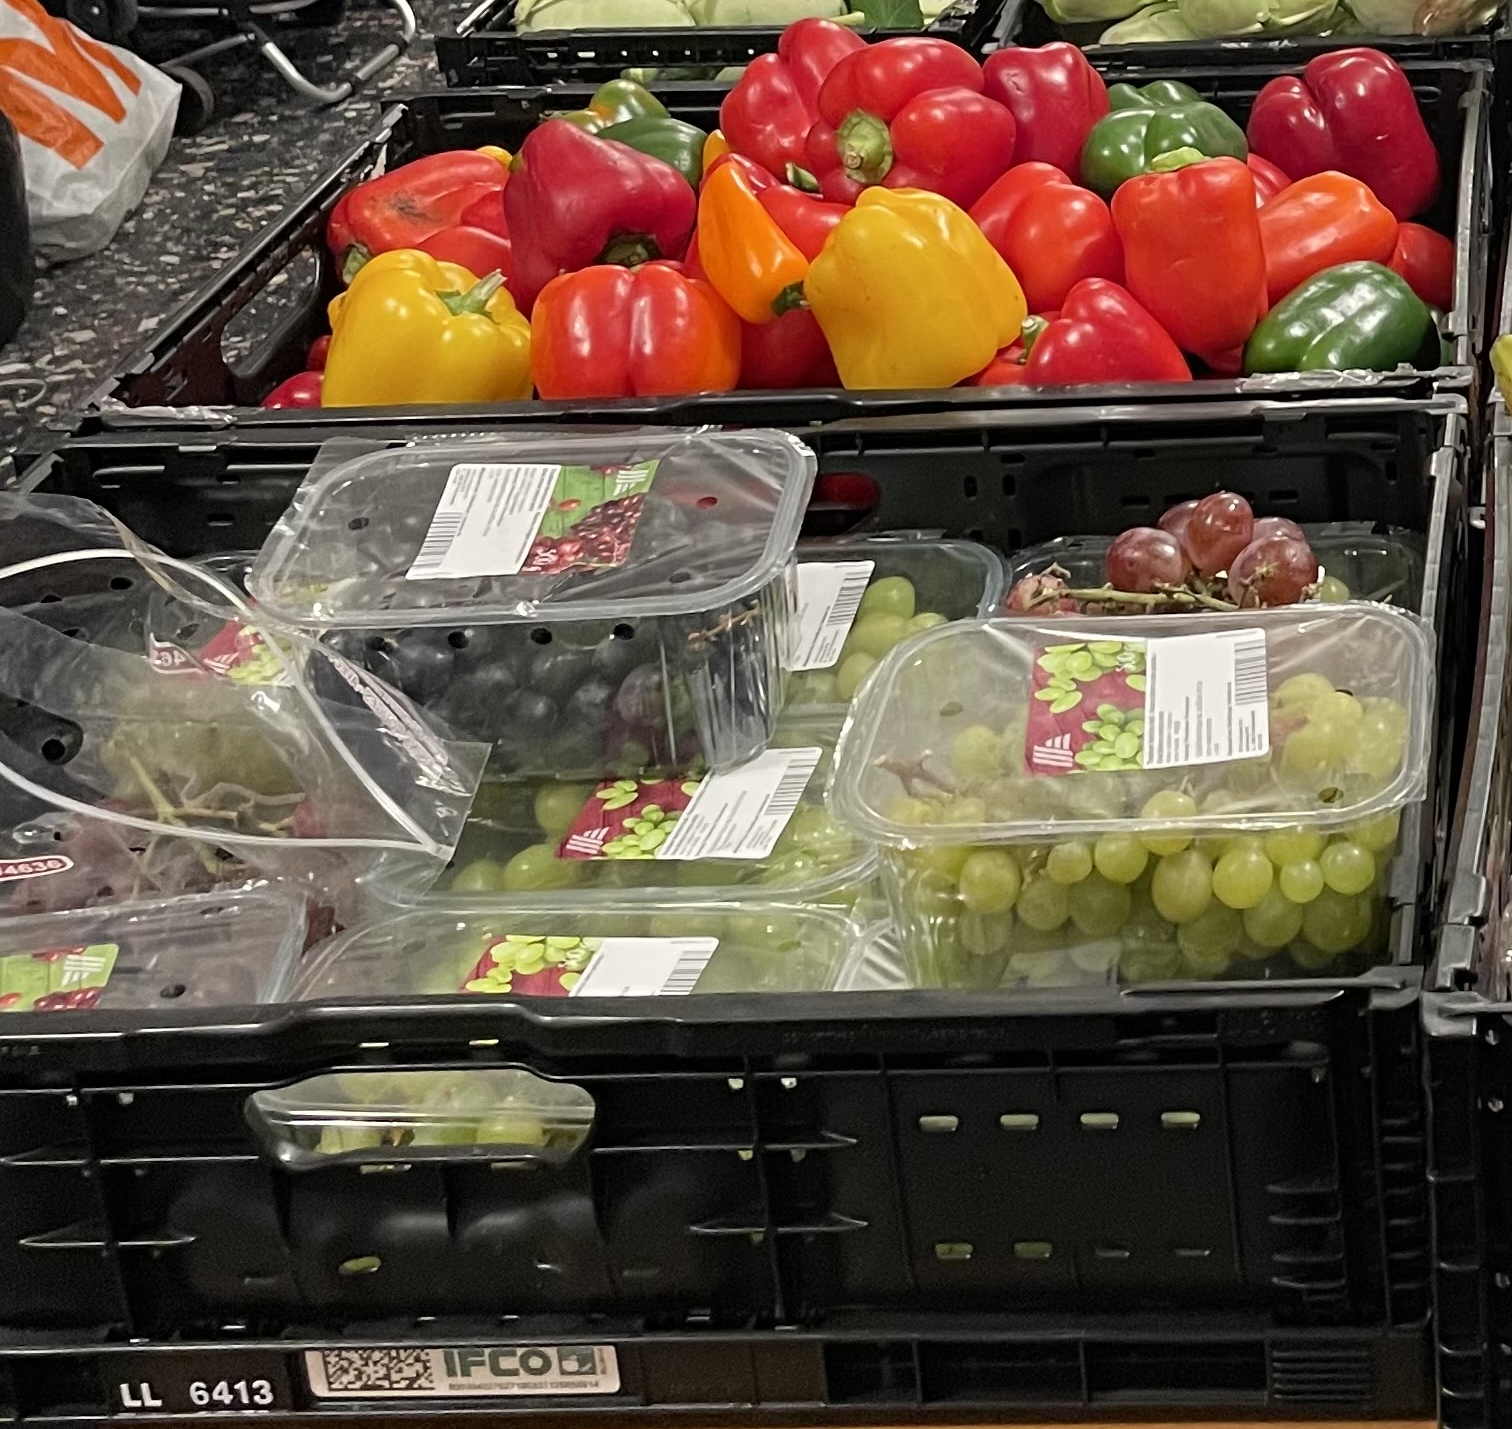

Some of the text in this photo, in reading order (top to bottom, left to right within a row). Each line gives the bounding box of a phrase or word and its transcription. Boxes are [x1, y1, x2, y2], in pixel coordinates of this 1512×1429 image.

[443, 1347, 552, 1377] IFCO
[120, 1379, 275, 1407] LL 6413
